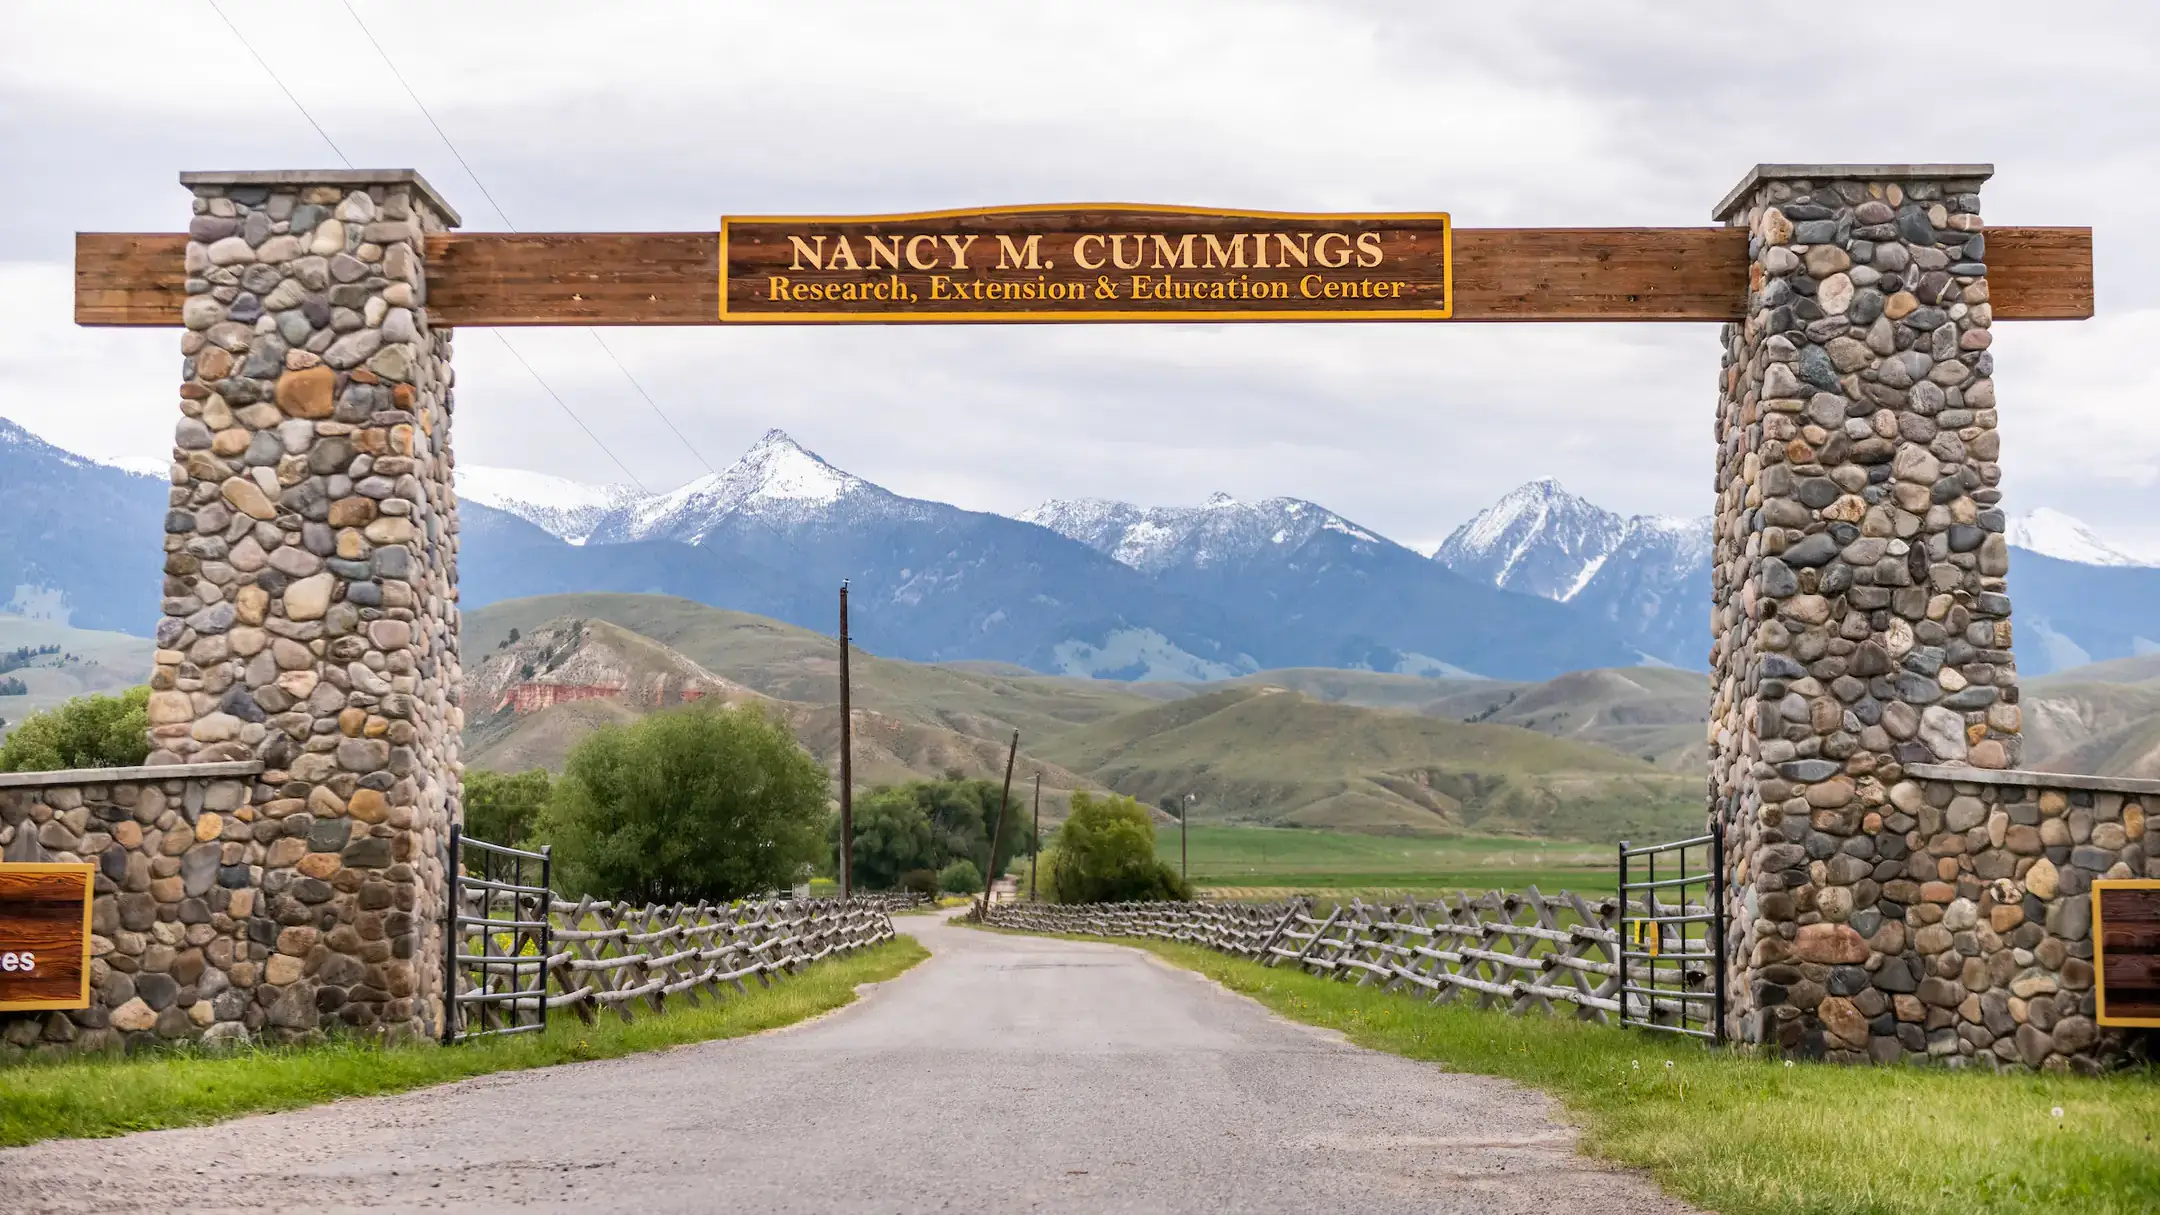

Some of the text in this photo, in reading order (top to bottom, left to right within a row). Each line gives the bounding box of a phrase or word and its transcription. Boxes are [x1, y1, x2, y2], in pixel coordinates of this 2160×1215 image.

[787, 232, 1384, 271] NANCY M. CUMMINGS
[767, 274, 1406, 304] Research, Extension & Education Center
[0, 951, 36, 972] es
